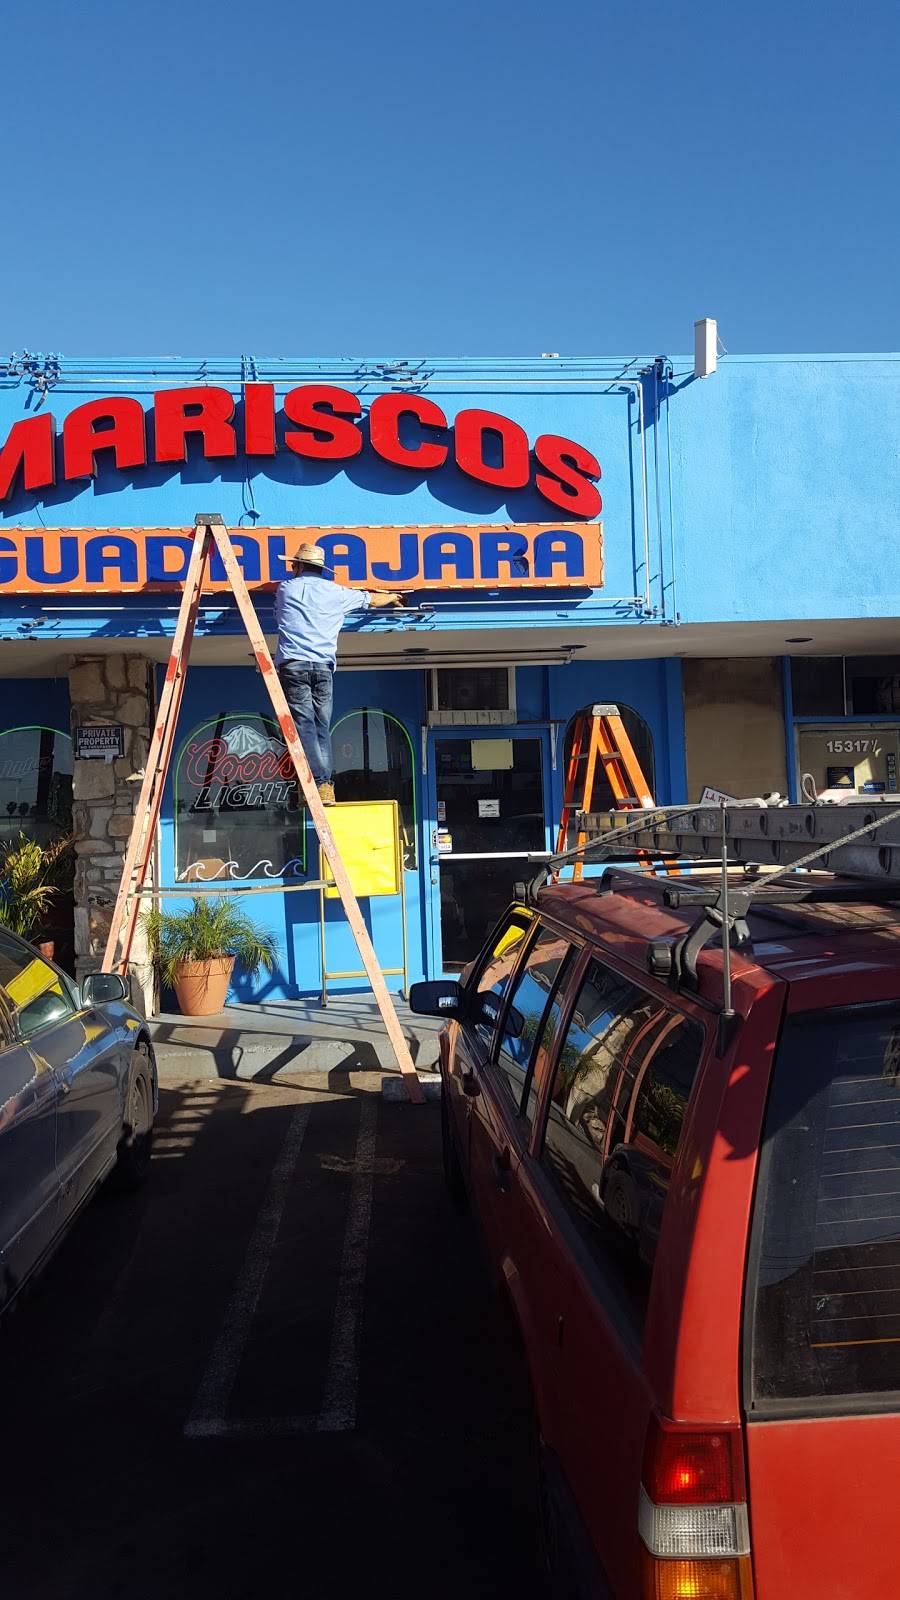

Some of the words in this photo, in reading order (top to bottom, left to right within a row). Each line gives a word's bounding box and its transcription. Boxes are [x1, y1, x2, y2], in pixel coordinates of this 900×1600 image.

[78, 737, 120, 746] PROPERTY
[82, 729, 116, 737] PRIVATE
[187, 738, 297, 786] Coors
[194, 781, 297, 810] LIGHT
